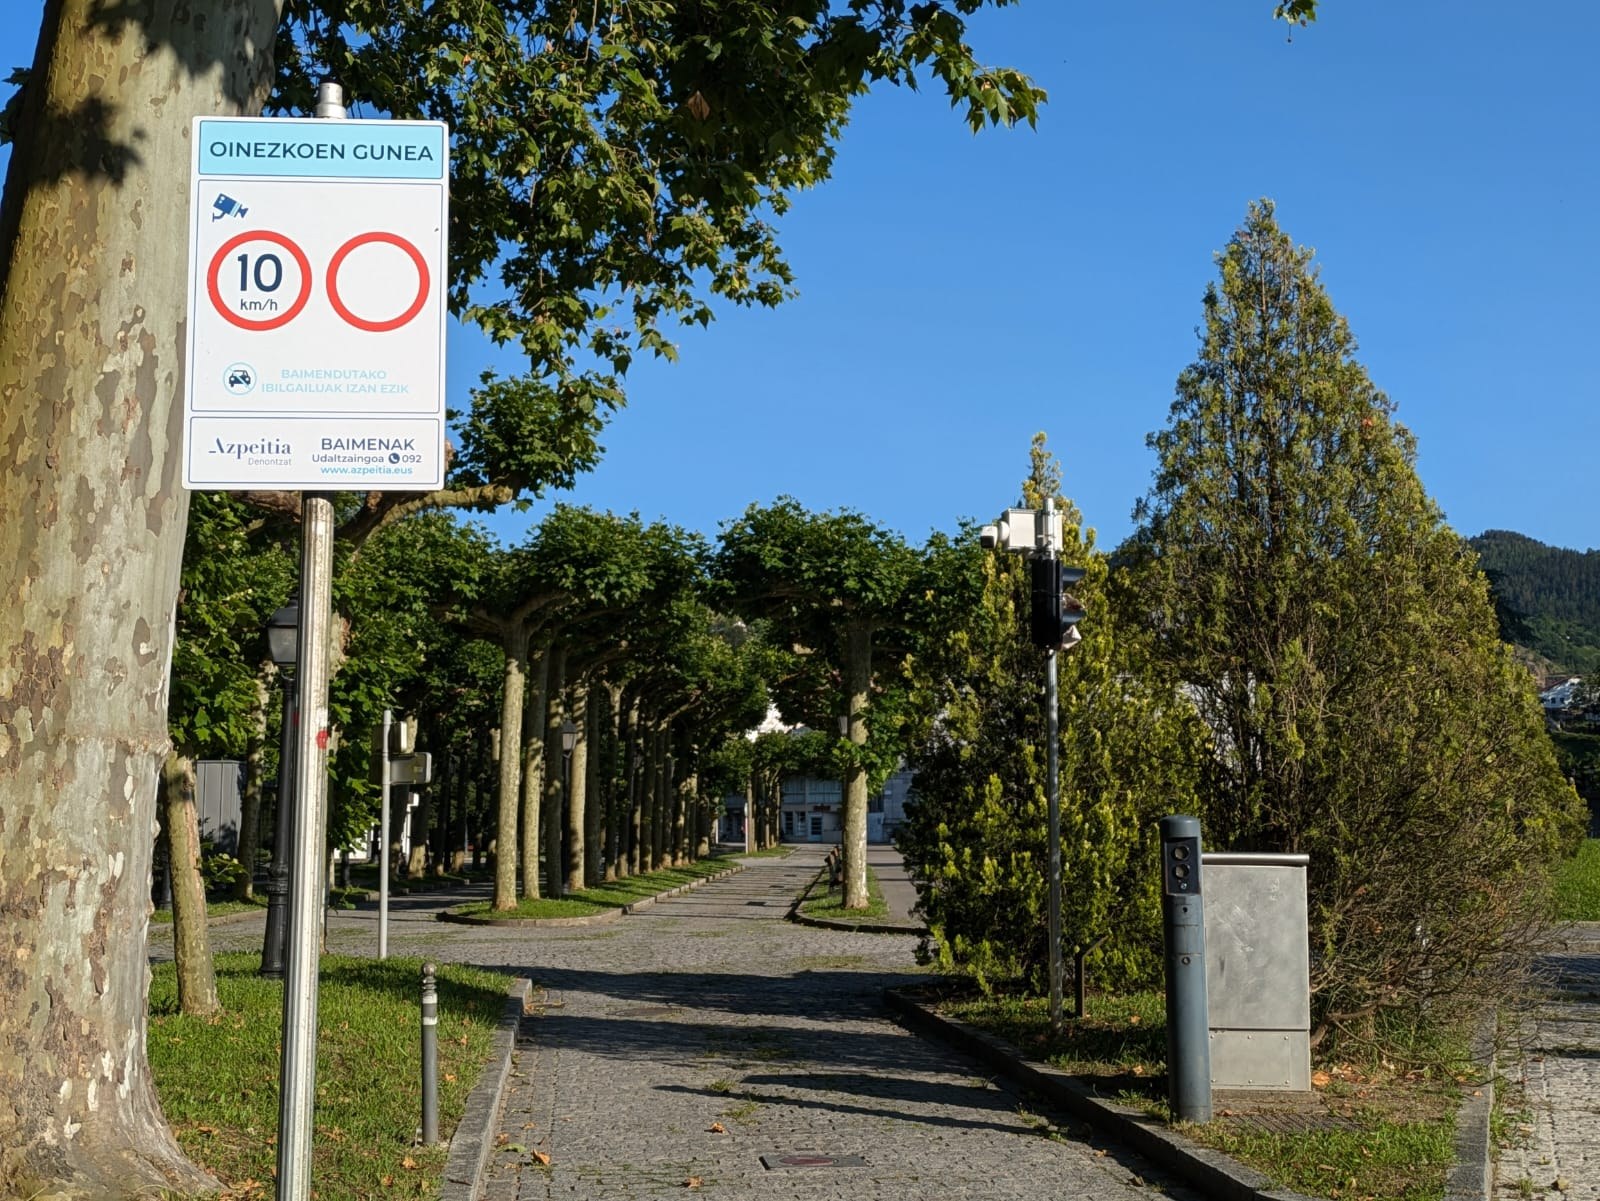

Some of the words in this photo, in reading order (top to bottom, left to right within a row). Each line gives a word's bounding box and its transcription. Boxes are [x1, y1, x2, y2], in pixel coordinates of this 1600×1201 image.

[210, 141, 345, 160] OINEZKOEN
[352, 144, 434, 161] GUNEA
[237, 253, 283, 293] 10
[240, 297, 278, 312] km/h
[281, 369, 387, 380] BAIMENDUTAKO
[261, 383, 342, 394] IBILGAILUAK
[346, 384, 377, 394] IZAN
[380, 385, 409, 395] EZIK
[208, 437, 291, 460] Azpeitia
[321, 438, 415, 451] BAIMENAK
[248, 457, 292, 466] Denontzat
[311, 453, 384, 465] Udaltzaingoa
[402, 454, 422, 464] 092
[320, 465, 413, 476] www.azpeitia.eus
